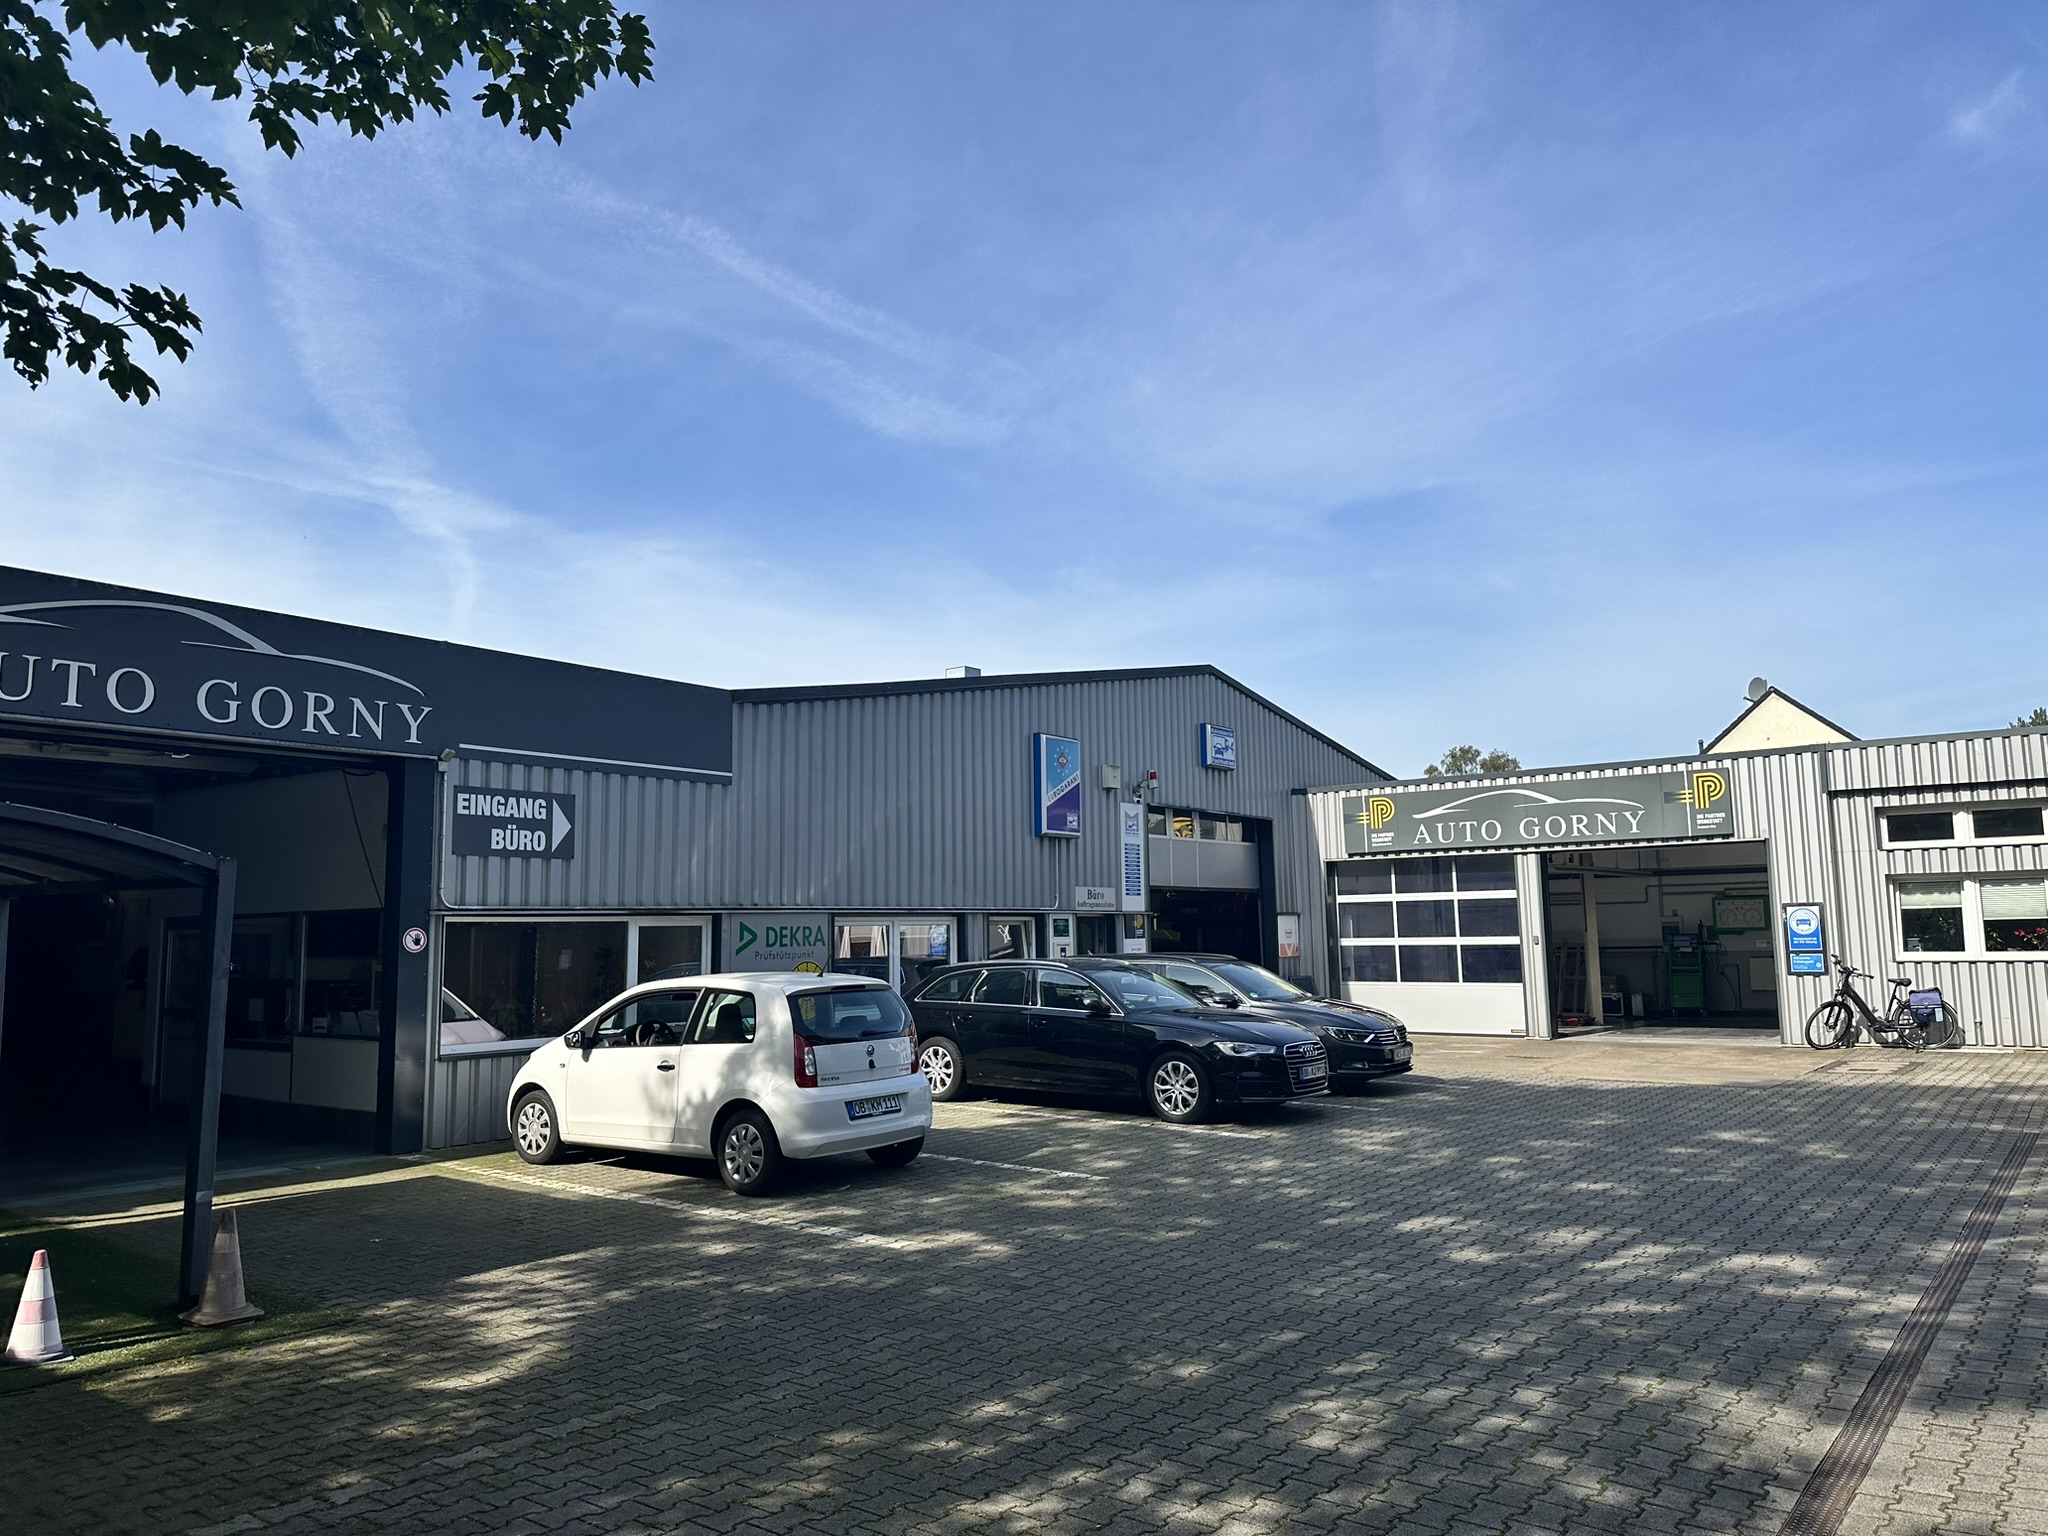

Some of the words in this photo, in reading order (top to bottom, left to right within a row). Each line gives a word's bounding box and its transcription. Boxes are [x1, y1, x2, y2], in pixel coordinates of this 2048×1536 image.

[196, 679, 433, 744] GORNY
[1047, 773, 1080, 803] EUROGARANT
[457, 793, 547, 820] EINGANG
[490, 824, 546, 851] BÜRO
[1413, 819, 1502, 844] AUTO
[1519, 810, 1646, 839] GORNY
[1087, 889, 1105, 900] Büro
[765, 925, 826, 948] DEKRA
[754, 949, 815, 961] Prüfstützpunkt
[854, 1101, 866, 1114] OB
